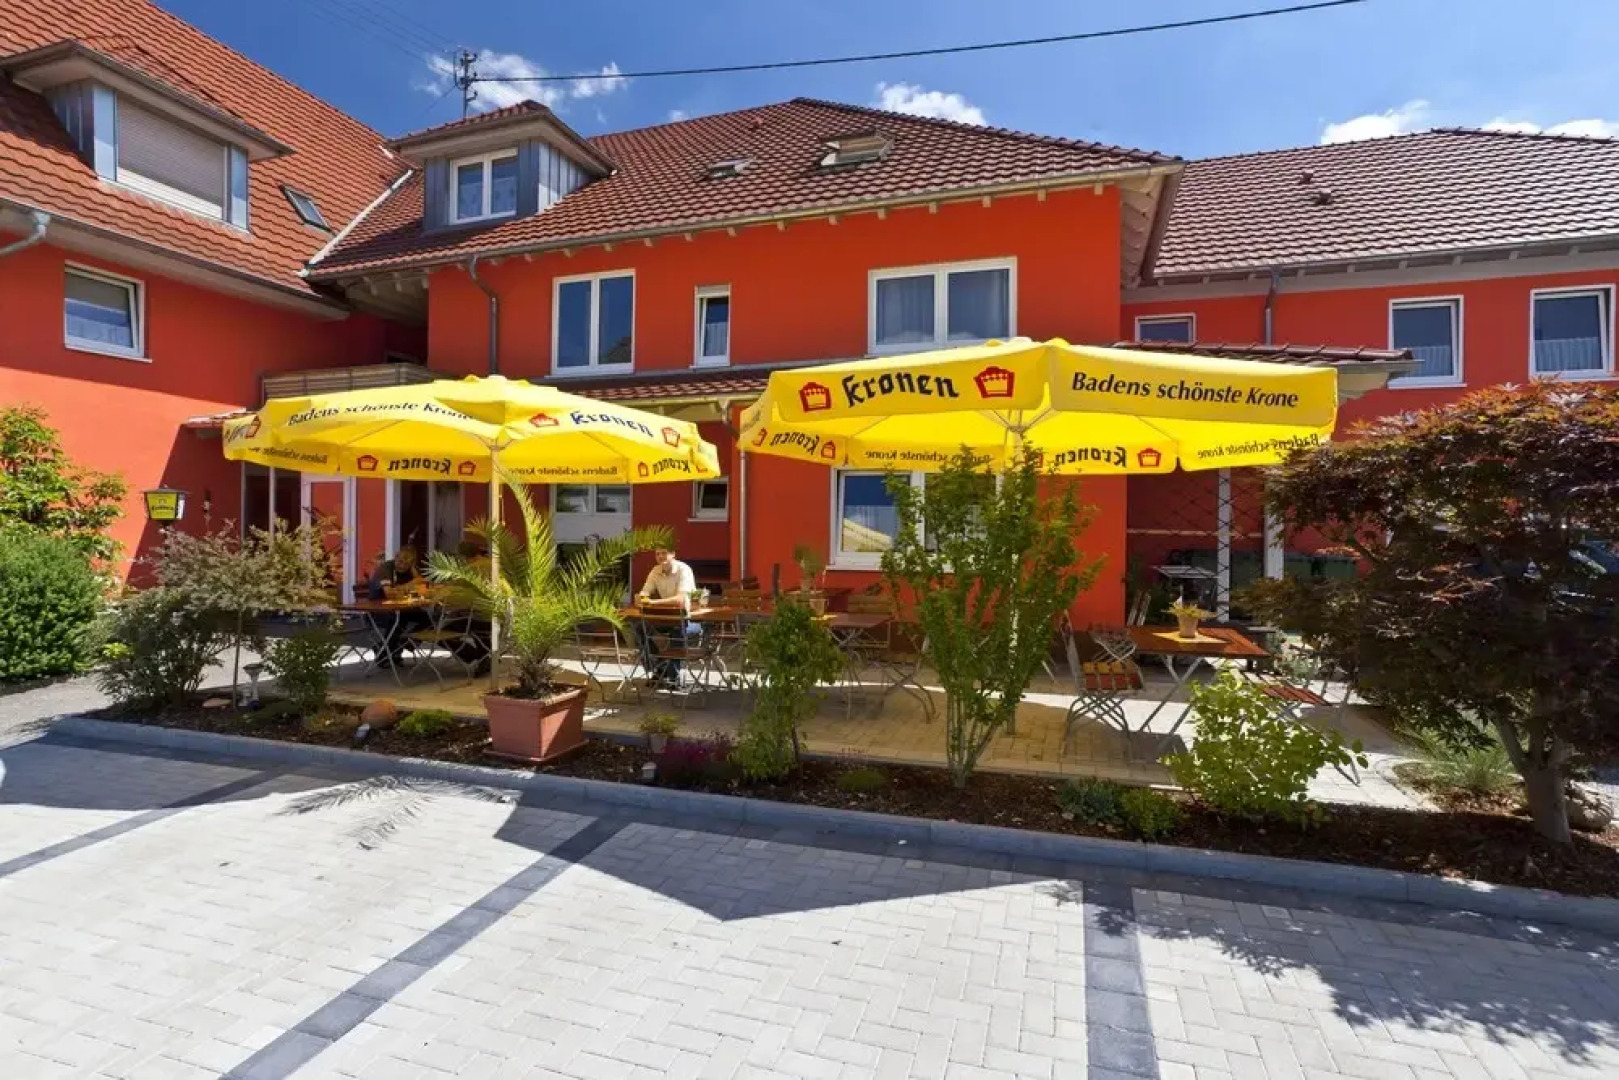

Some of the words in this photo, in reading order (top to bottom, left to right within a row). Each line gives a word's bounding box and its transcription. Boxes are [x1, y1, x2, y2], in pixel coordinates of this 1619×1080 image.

[842, 371, 959, 408] Kronen
[1071, 372, 1151, 397] Badens
[1156, 380, 1243, 404] schönste
[1246, 387, 1299, 408] Krone
[286, 408, 338, 427] Badens
[570, 410, 654, 438] Kronen
